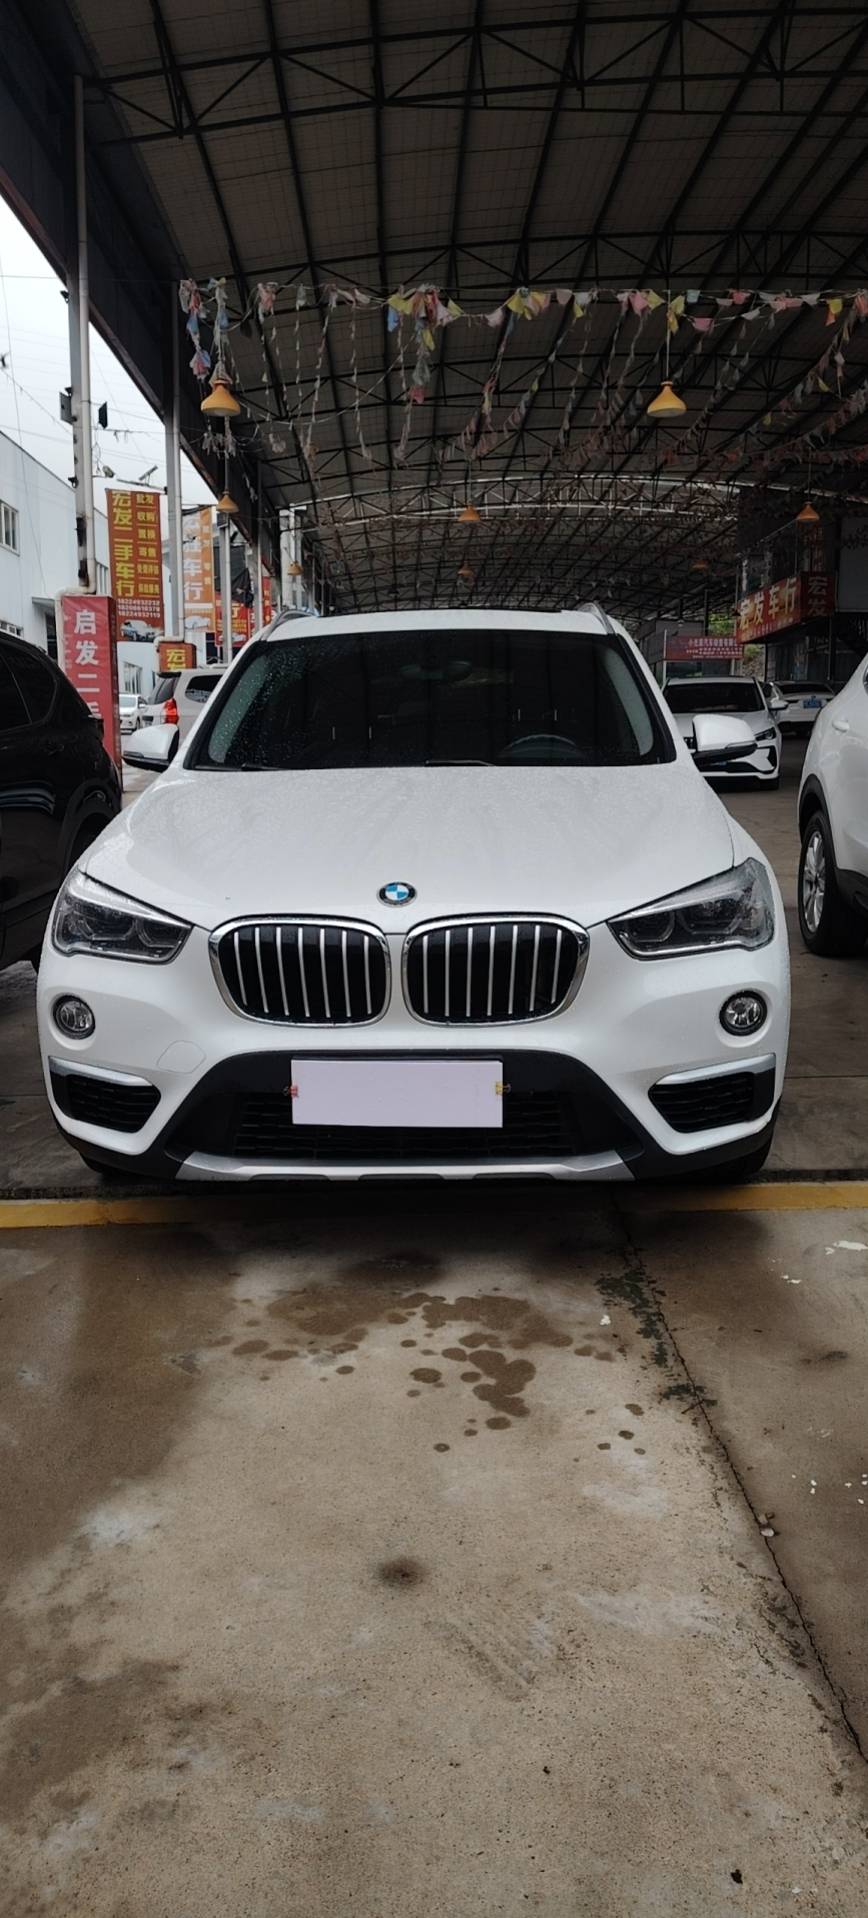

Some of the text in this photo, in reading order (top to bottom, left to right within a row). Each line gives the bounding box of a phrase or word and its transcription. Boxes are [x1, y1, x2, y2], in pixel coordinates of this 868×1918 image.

[112, 491, 135, 598] 宏发二手车行
